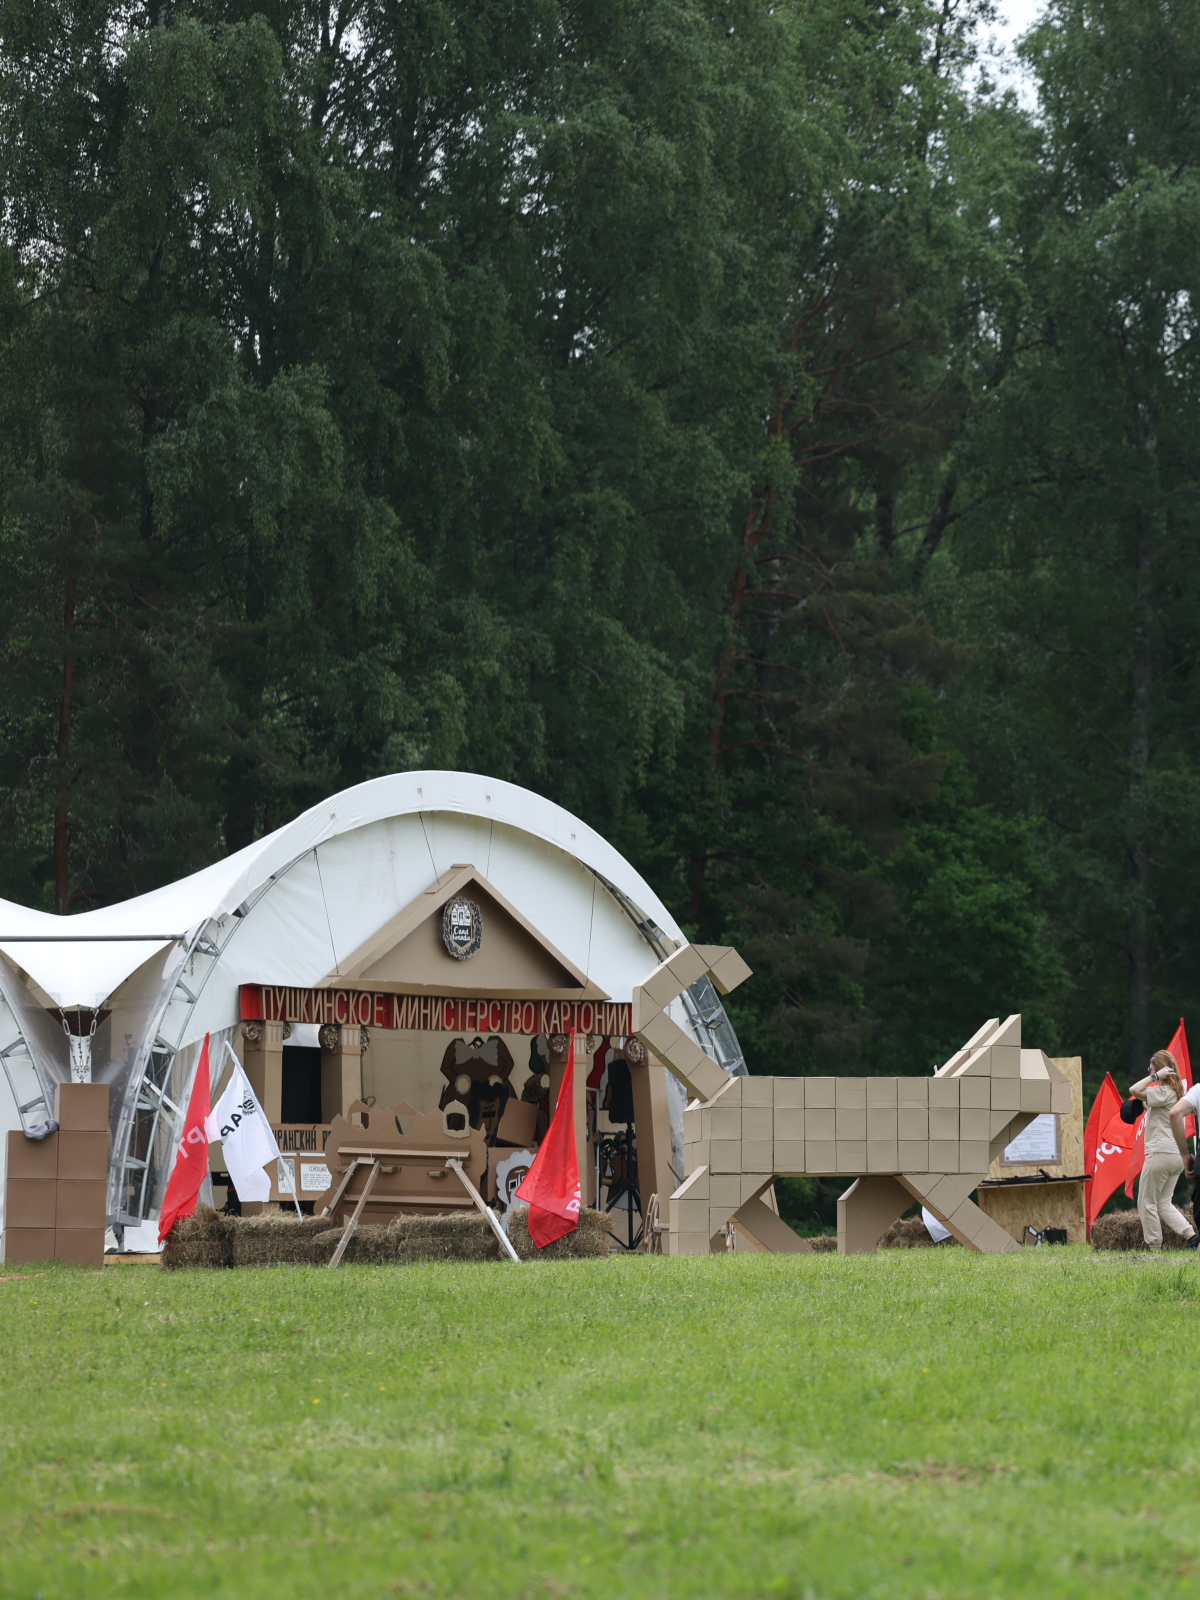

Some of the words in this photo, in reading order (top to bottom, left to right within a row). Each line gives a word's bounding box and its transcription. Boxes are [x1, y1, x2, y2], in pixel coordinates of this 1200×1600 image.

[261, 985, 385, 1028] ПУШКИНСКОЕ
[393, 995, 535, 1034] МИНИСТЕРСТВО
[540, 1000, 630, 1036] КАРТОНИИ
